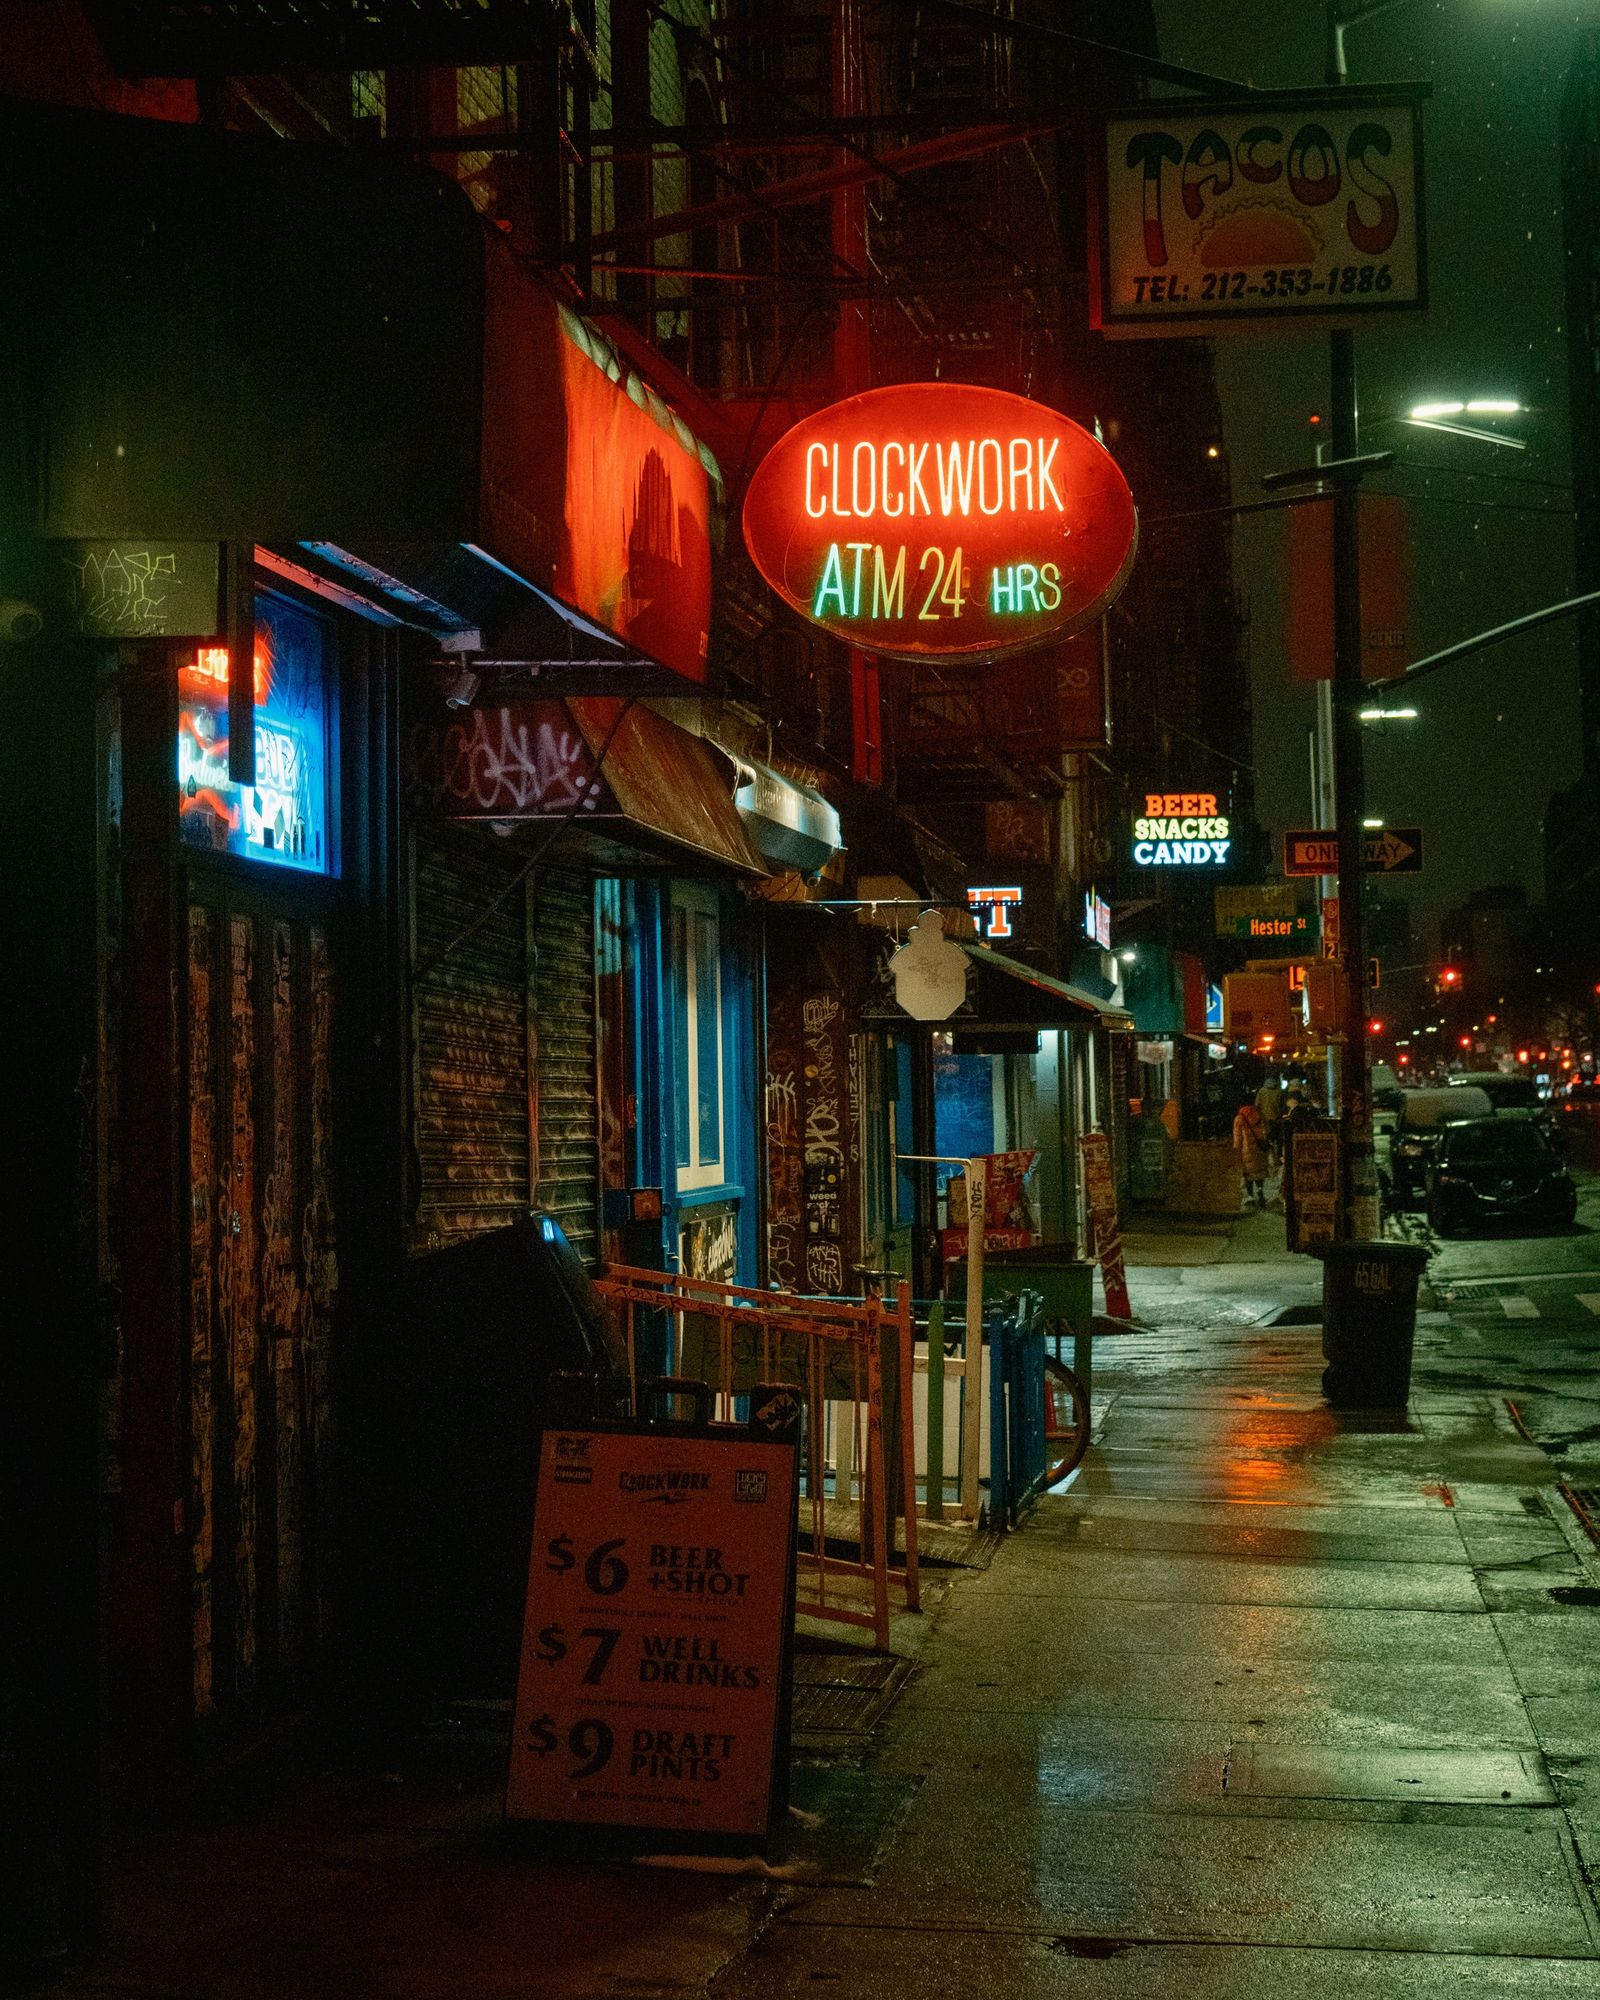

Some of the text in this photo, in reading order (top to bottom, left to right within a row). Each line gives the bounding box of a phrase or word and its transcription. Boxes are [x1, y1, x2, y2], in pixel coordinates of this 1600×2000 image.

[1126, 123, 1398, 268] TACOS
[1133, 265, 1393, 304] TEL: 212-353-1886
[805, 437, 1065, 519] CLOCKWORK
[814, 542, 1063, 621] ATM 24 HRS
[1145, 793, 1218, 817] BEER
[1134, 817, 1230, 841] SNACKS
[1133, 840, 1231, 865] CANDY
[1250, 917, 1307, 936] Hester St
[650, 1544, 724, 1571] BEER
[649, 1570, 751, 1597] +SHOT
[642, 1635, 724, 1662] WELL
[639, 1659, 760, 1690] DRINKS
[631, 1728, 736, 1758] DRAFT
[630, 1755, 721, 1783] PINTS
